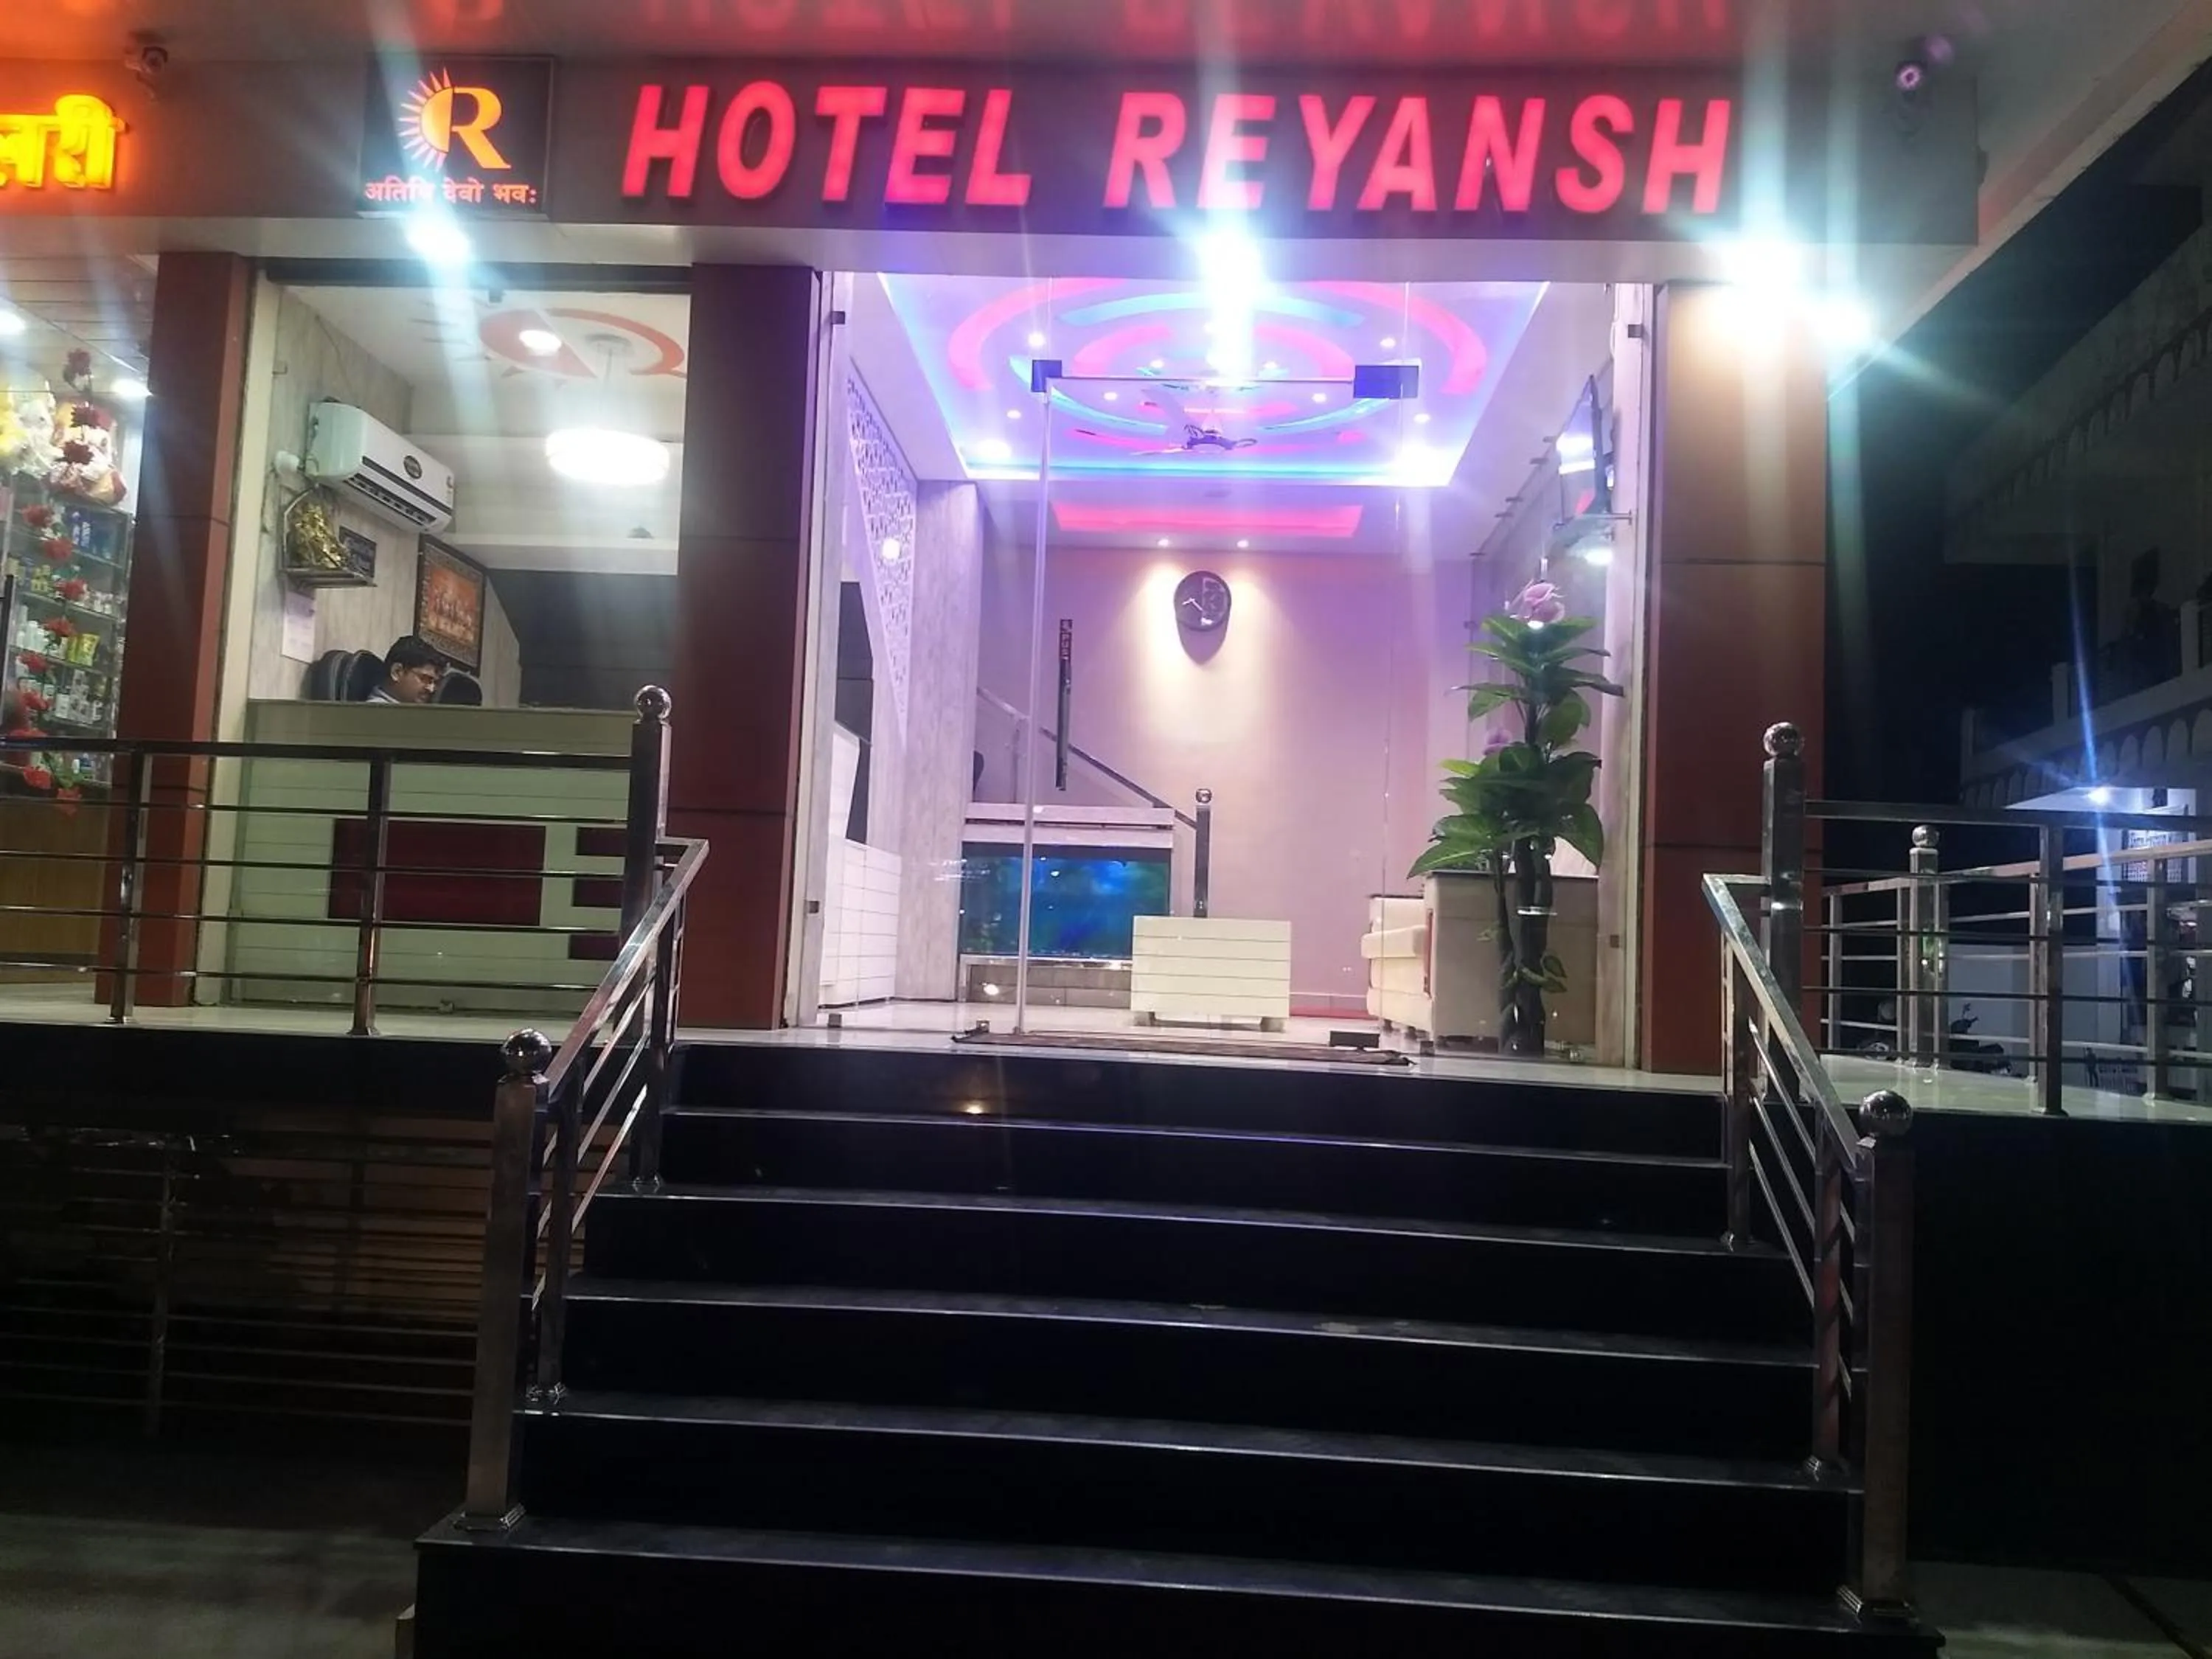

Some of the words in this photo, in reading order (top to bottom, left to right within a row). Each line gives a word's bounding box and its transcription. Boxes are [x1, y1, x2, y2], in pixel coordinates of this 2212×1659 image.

[422, 86, 512, 170] R
[621, 81, 1031, 206] HOTEL
[1103, 91, 1731, 214] REYANSH
